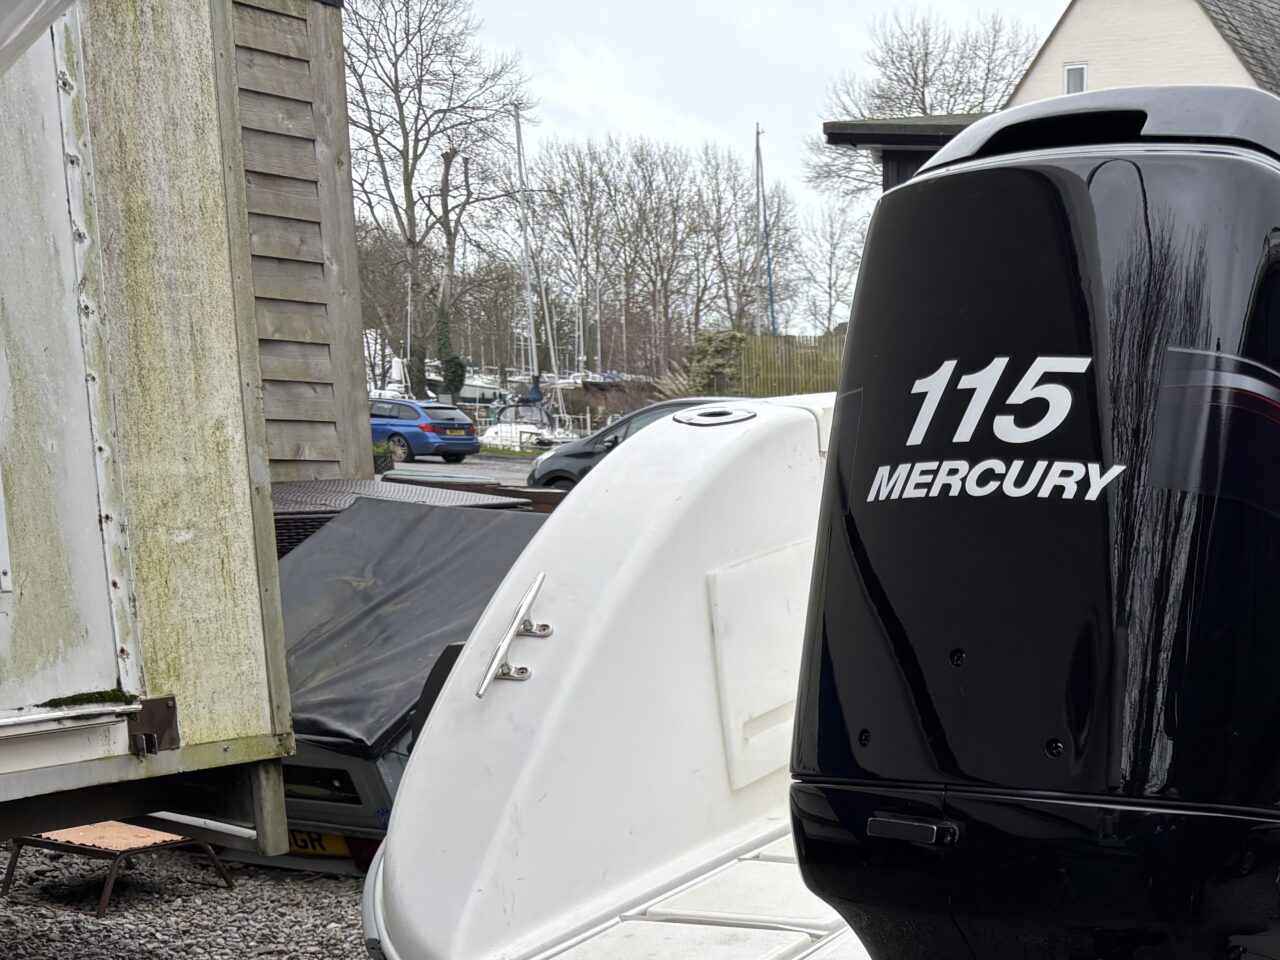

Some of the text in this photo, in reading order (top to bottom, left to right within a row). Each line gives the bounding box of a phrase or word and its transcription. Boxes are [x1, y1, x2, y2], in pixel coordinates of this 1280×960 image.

[906, 356, 1092, 446] 115
[866, 458, 1127, 502] MERCURY
[289, 829, 327, 851] GR
